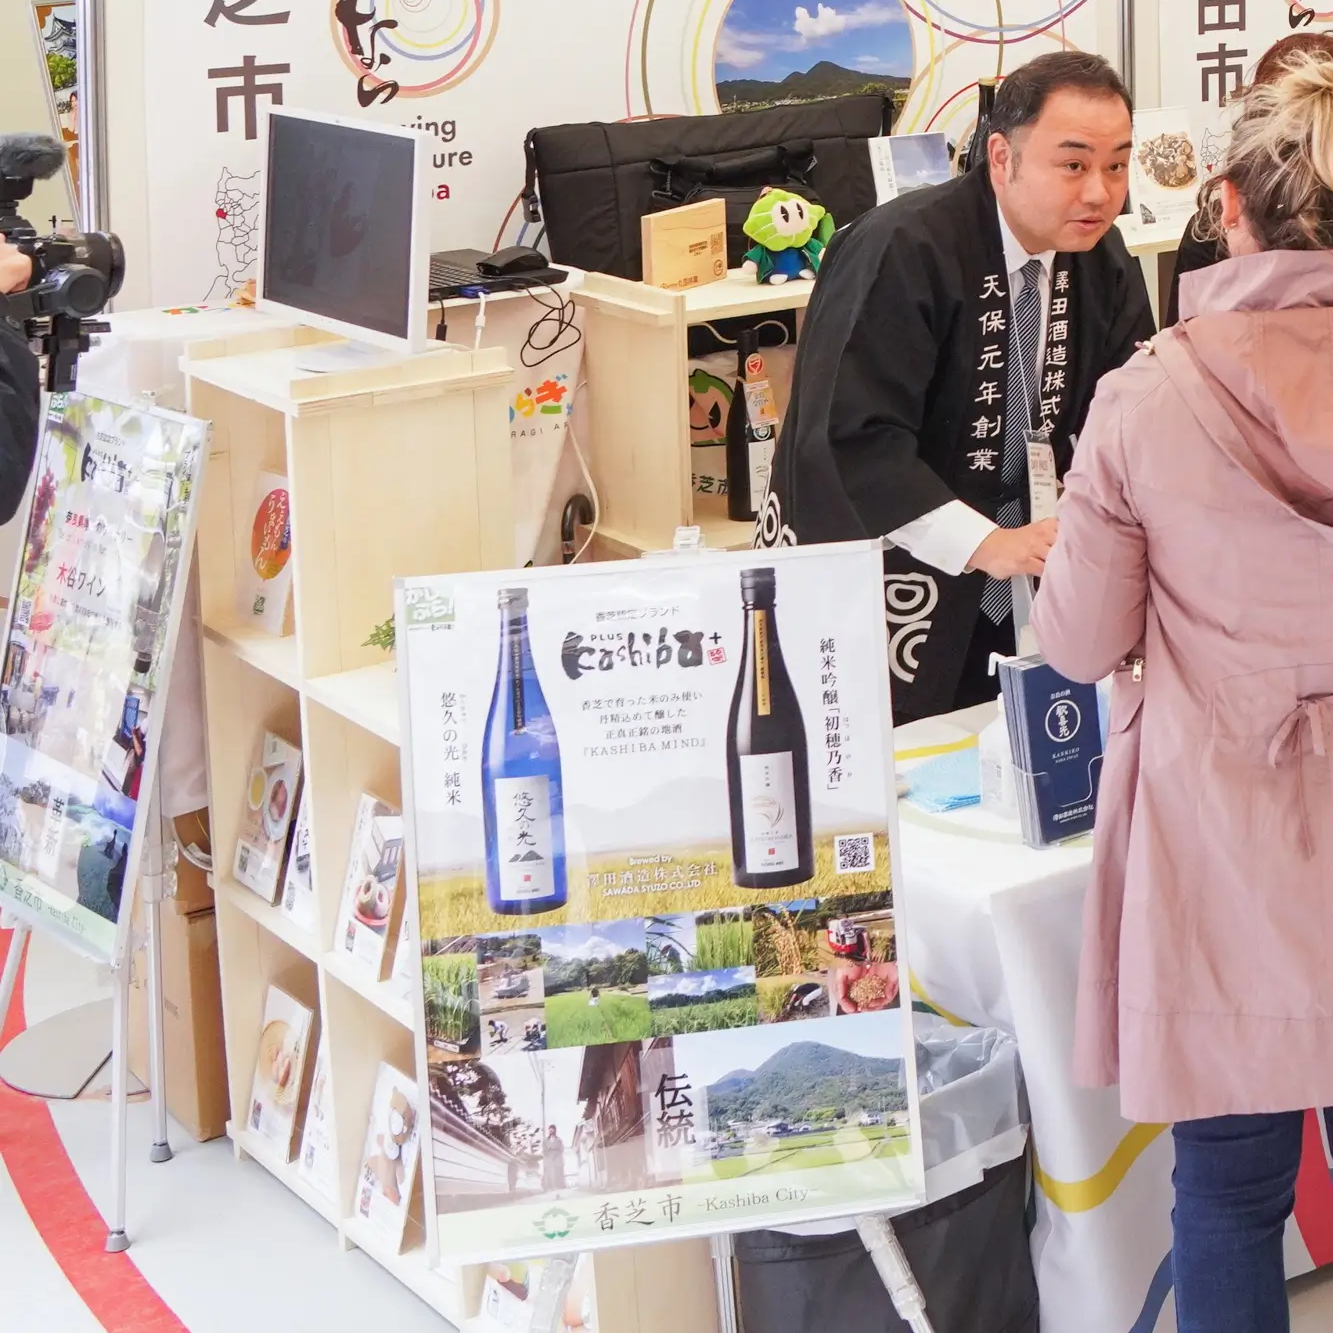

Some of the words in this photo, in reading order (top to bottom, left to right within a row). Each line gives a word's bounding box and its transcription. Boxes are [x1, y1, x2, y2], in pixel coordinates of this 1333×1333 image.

[1037, 270, 1069, 435] 澤田酒造株式会
[969, 274, 1006, 471] 天保元年創業
[590, 633, 623, 641] PLUS
[582, 691, 703, 711] 香芝で育った米のみ使い
[440, 692, 459, 762] 悠久の光
[600, 708, 687, 724] 丹精込めて醸した
[605, 723, 683, 740] 正真正銘の地酒
[444, 772, 461, 805] 純米
[628, 855, 660, 865] Brewed
[661, 854, 673, 864] by
[602, 886, 639, 897] SAWADA
[640, 883, 668, 893] SYUZO
[654, 1072, 696, 1149] 伝統
[593, 1193, 683, 1231] 香芝市
